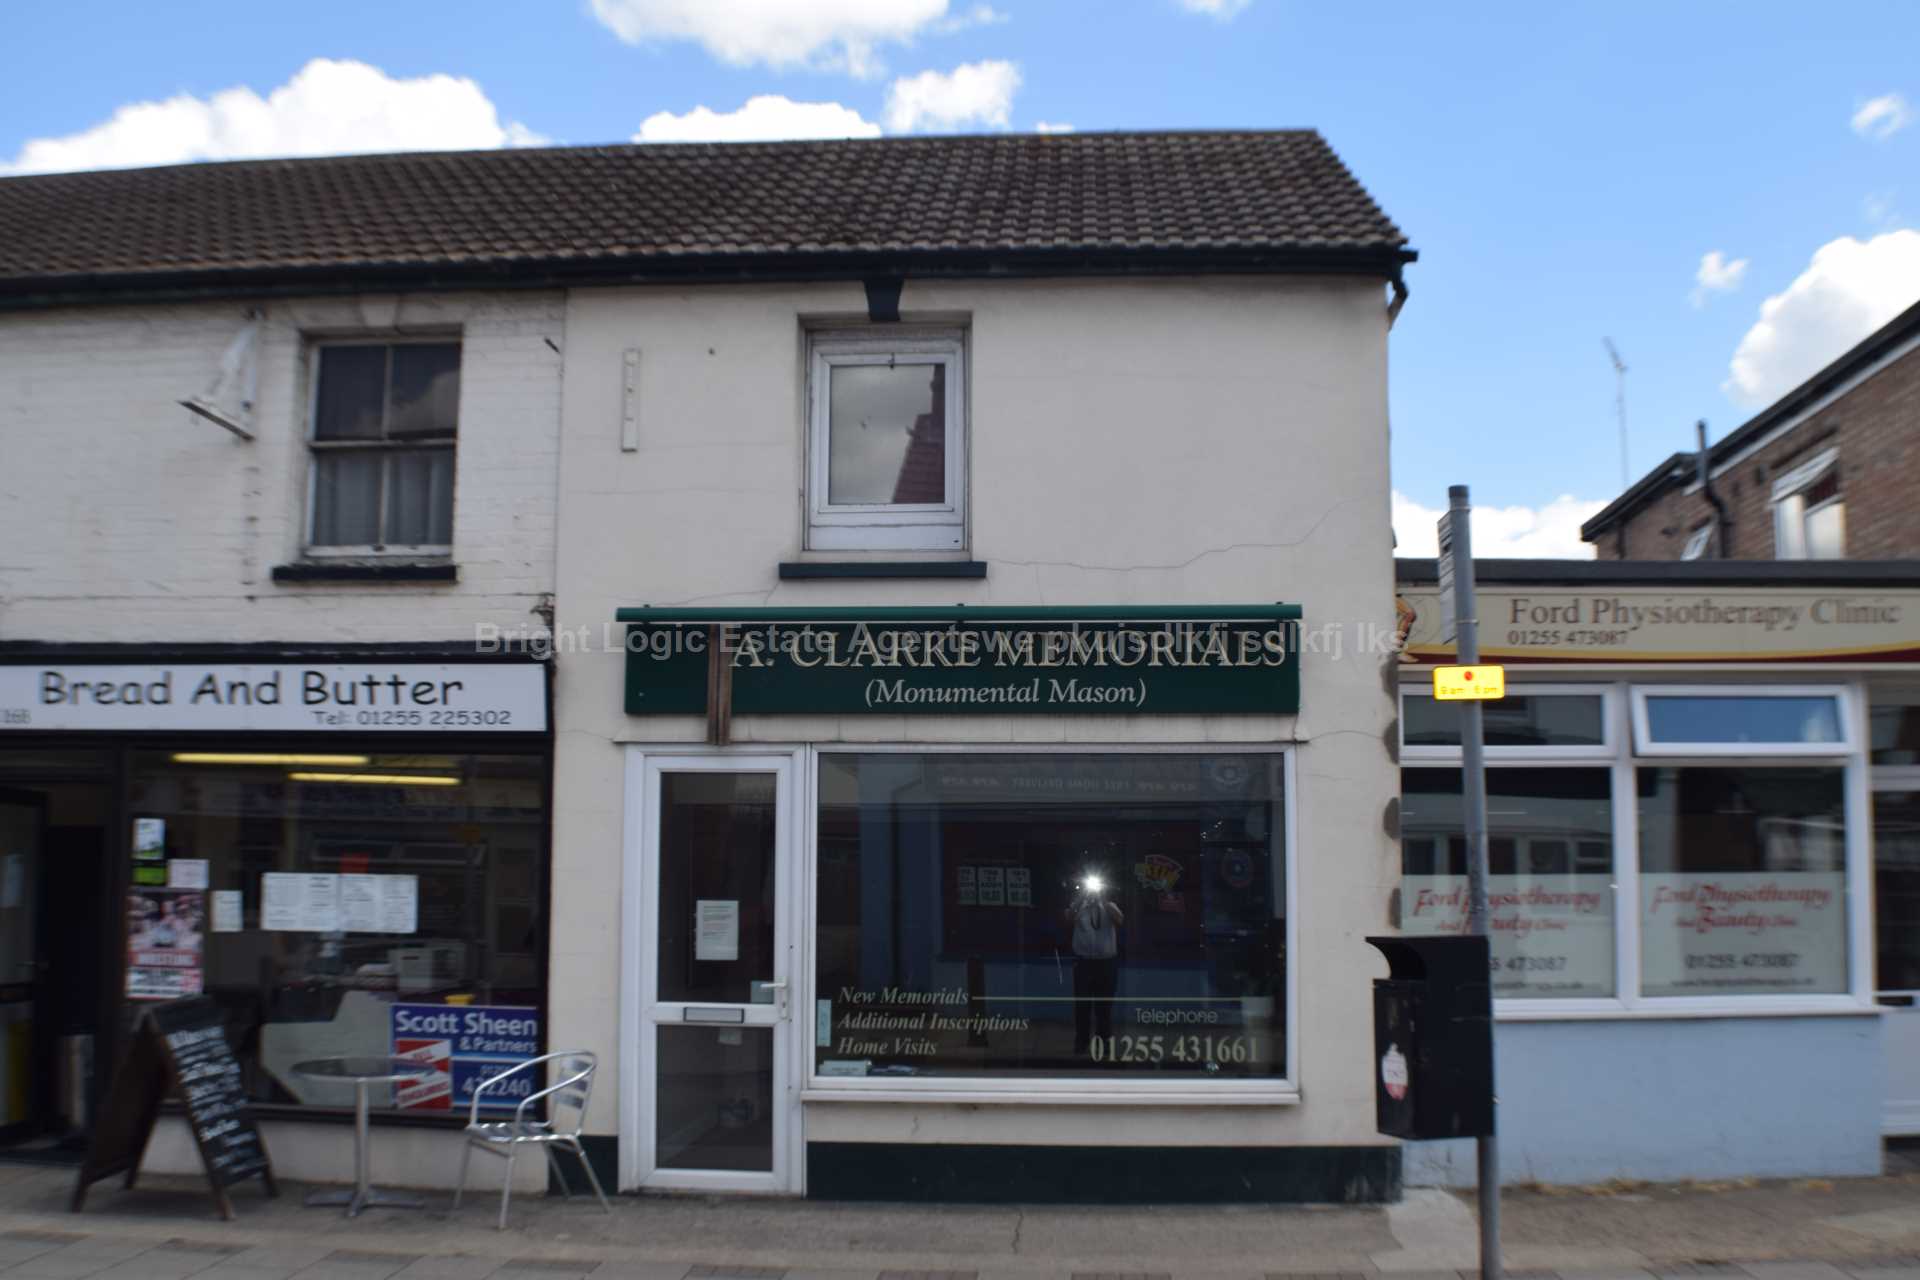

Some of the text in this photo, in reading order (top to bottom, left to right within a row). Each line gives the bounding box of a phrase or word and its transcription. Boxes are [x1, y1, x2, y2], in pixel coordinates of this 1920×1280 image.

[1510, 598, 1899, 631] Ford Physiotherapy Clinic
[728, 629, 1287, 668] A. CLARKE MEMORIALS
[1506, 629, 1629, 646] 01255 473087
[40, 671, 464, 705] Bread And Butter
[865, 677, 1147, 708] (Monumental Mason)
[313, 711, 512, 726] Tel: 01255 225302
[1412, 885, 1462, 916] Ford
[838, 986, 969, 1005] New Memorials
[395, 1010, 537, 1036] Scott Sheen
[837, 1011, 926, 1030] Additional
[929, 1011, 1030, 1031] Inscriptions
[1135, 1008, 1218, 1025] Telephone
[459, 1036, 536, 1053] & Partners
[837, 1037, 937, 1056] Home Visits
[1089, 1035, 1259, 1062] 01255 431661
